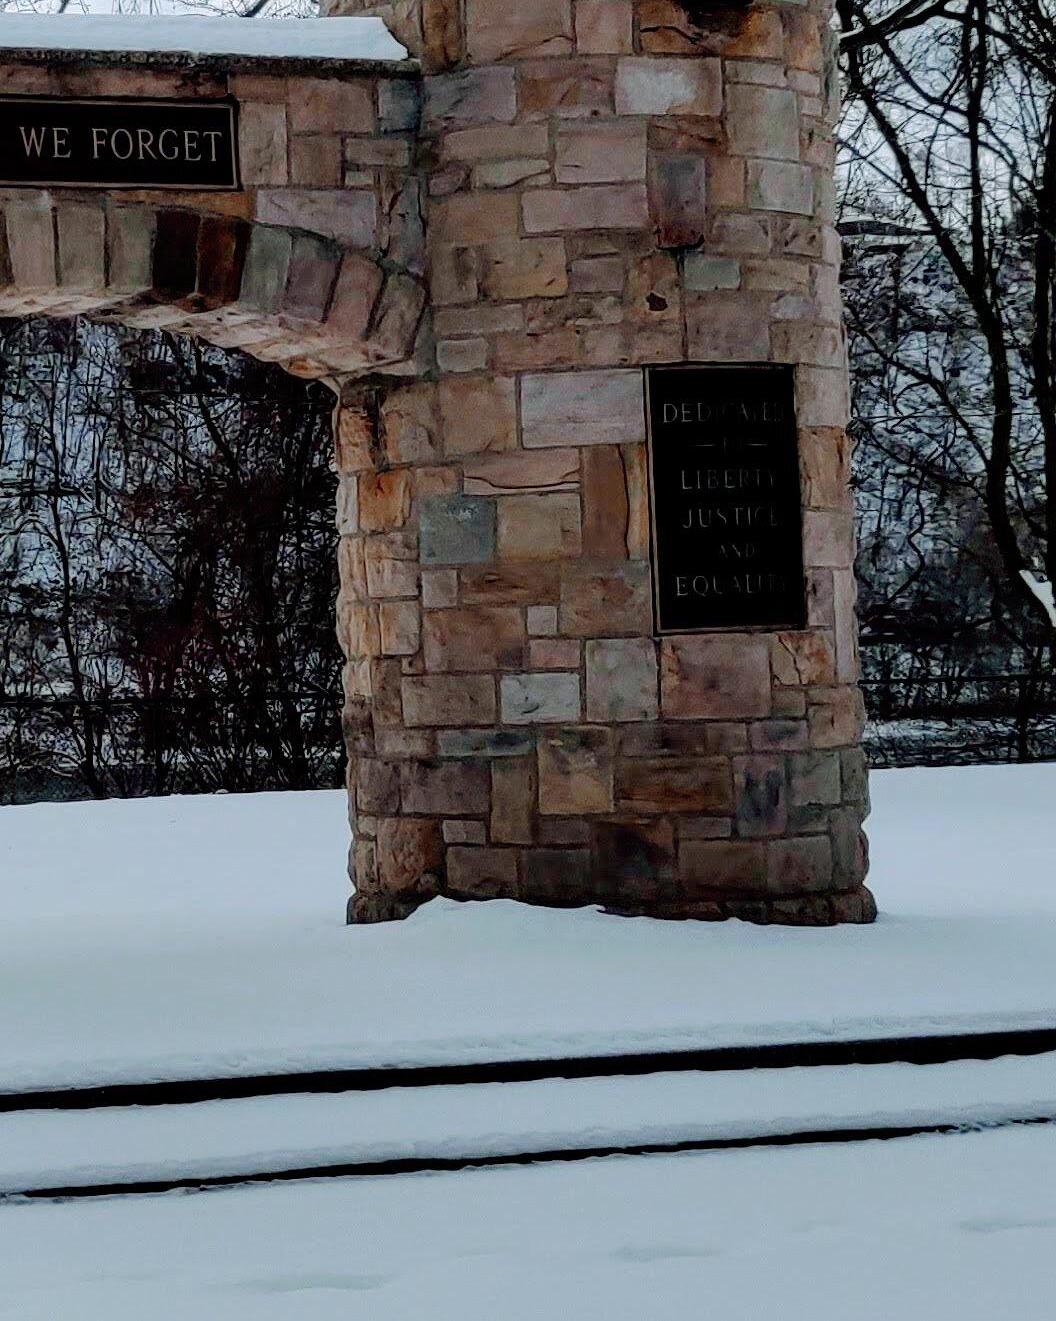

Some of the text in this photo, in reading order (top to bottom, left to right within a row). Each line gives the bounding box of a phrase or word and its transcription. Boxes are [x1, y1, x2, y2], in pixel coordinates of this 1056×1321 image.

[19, 125, 72, 158] WE
[91, 127, 223, 162] FORGET
[662, 401, 784, 423] DEDCAED
[681, 468, 776, 490] LIBERTY
[682, 506, 778, 529] JUSTICE
